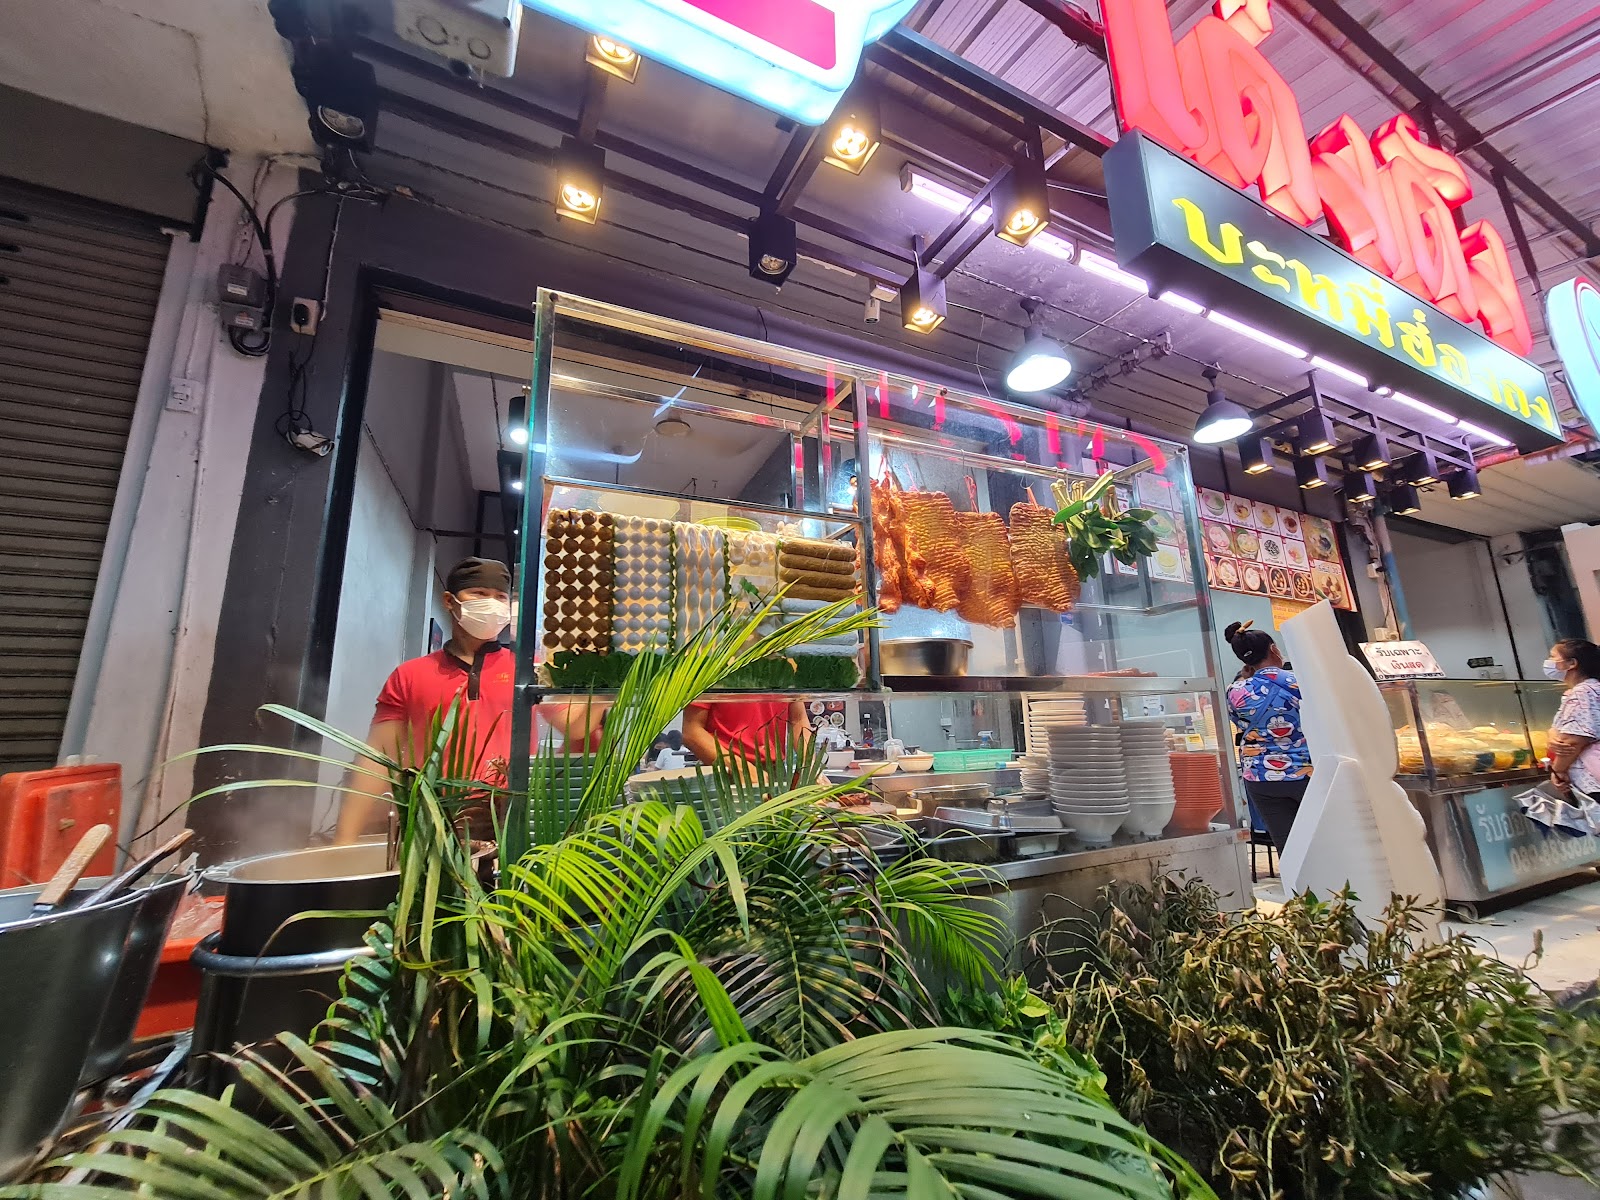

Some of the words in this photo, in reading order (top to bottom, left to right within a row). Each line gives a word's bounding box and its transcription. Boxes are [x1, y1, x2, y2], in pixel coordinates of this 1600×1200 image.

[1375, 647, 1423, 657] รับเฉพาะ
[1391, 660, 1425, 670] เงินสด
